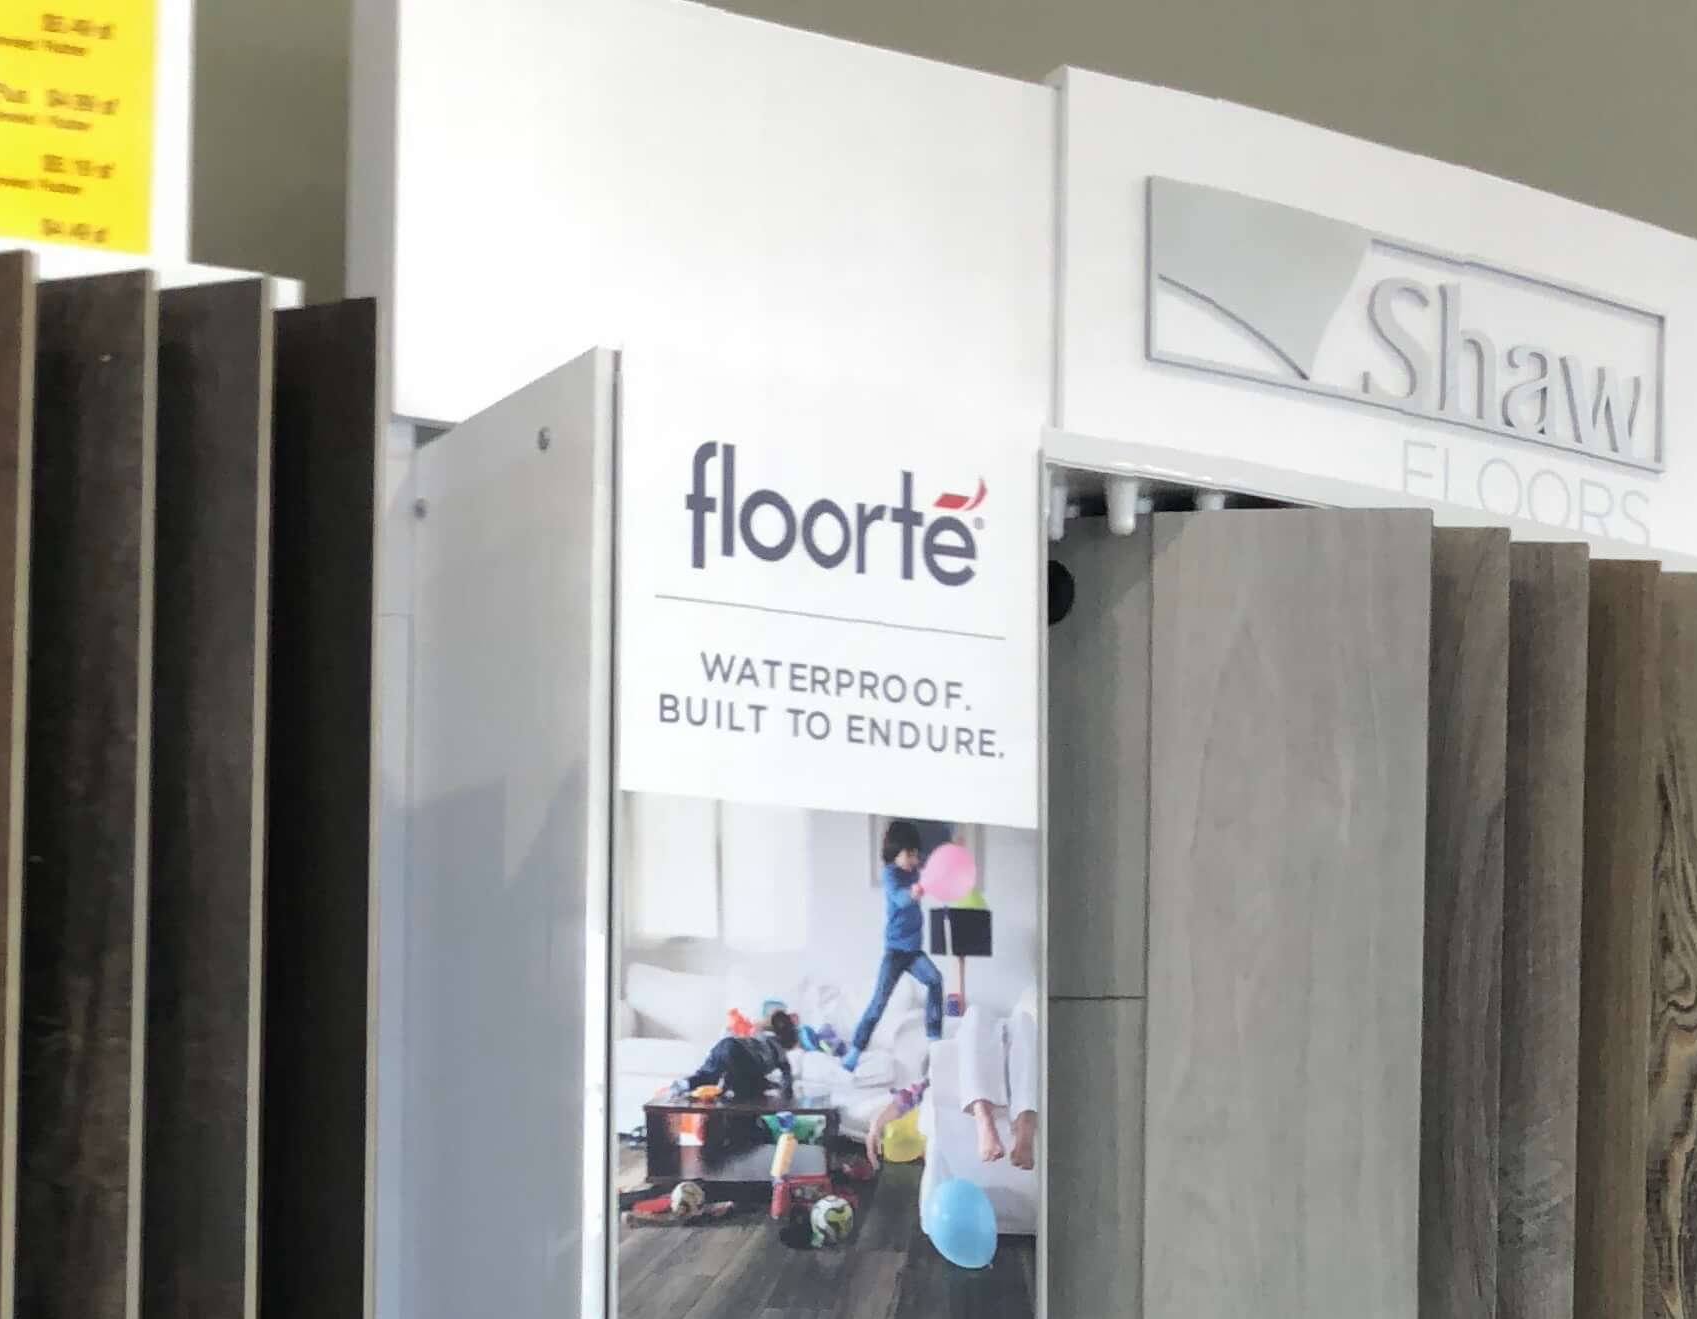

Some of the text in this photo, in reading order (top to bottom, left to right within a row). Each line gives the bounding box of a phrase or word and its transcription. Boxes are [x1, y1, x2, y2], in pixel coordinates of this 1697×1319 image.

[1362, 277, 1640, 452] Shaw
[1403, 440, 1649, 545] FLOORS
[700, 652, 971, 710] WATERPROOF.
[659, 695, 1004, 758] BUILT TO ENDURE.
